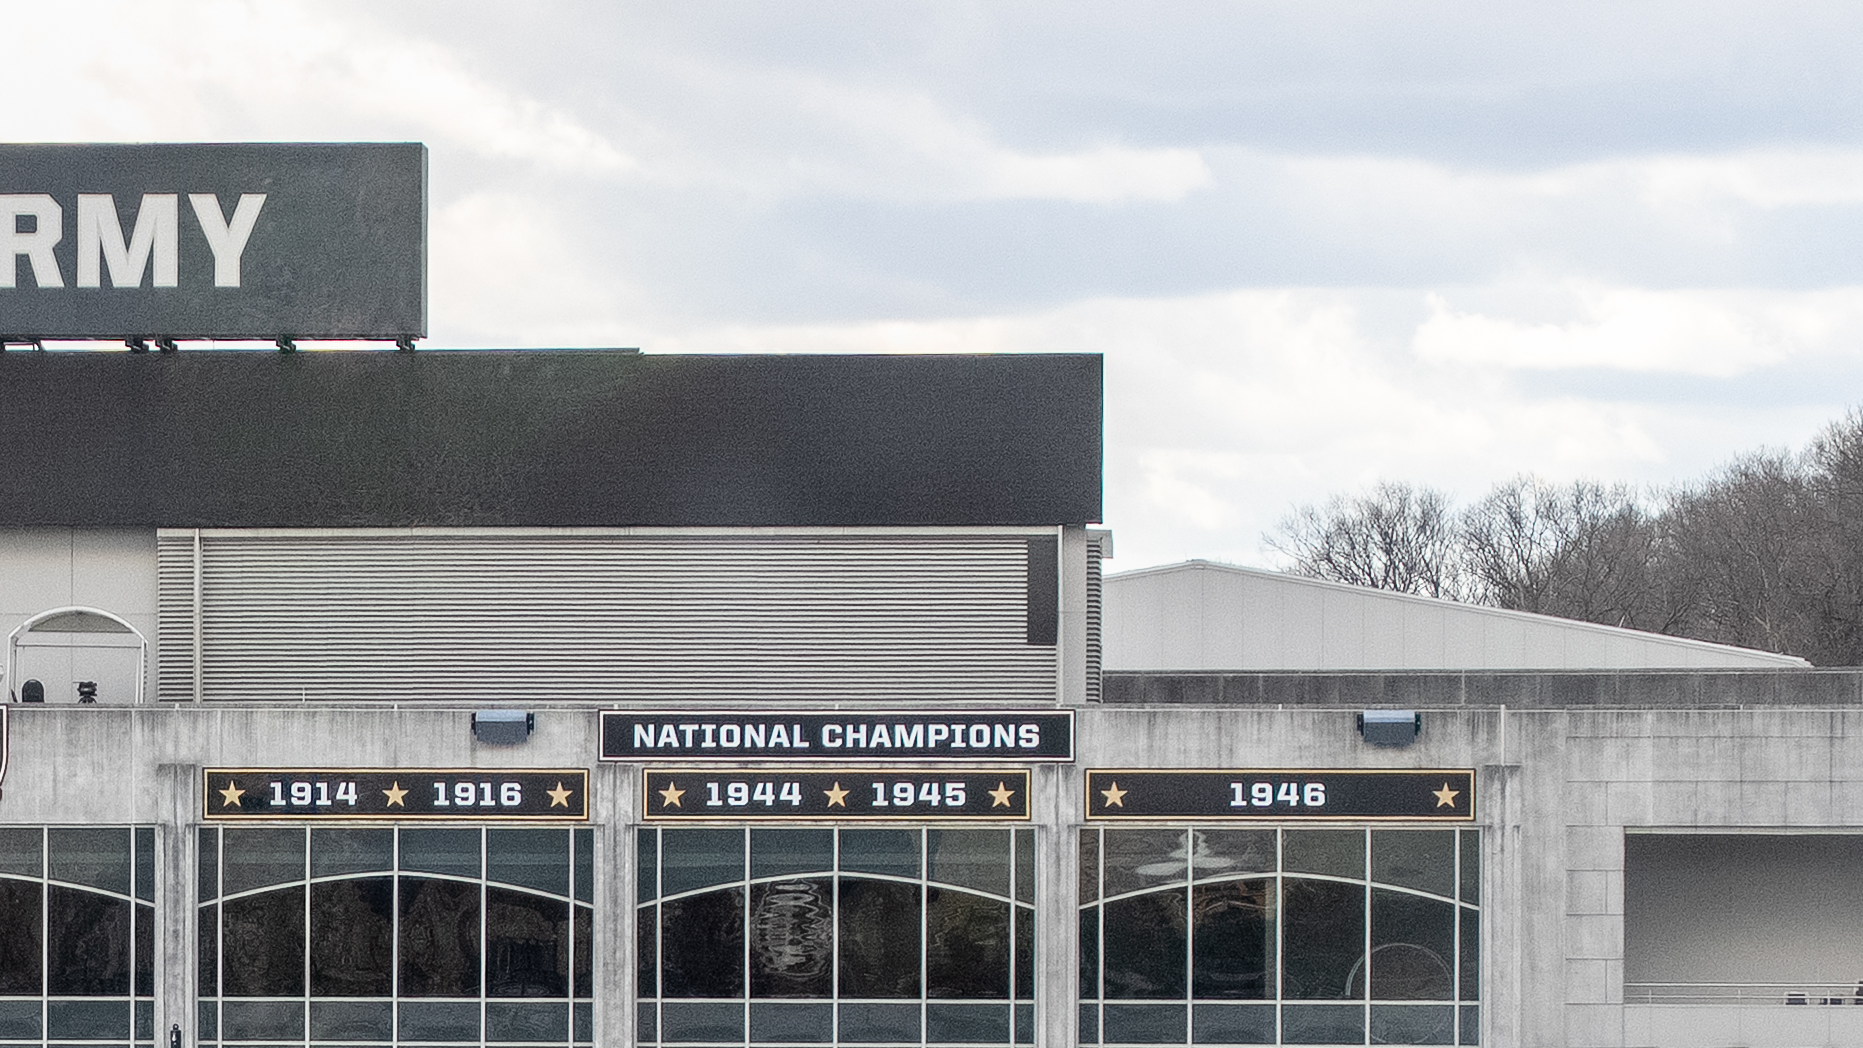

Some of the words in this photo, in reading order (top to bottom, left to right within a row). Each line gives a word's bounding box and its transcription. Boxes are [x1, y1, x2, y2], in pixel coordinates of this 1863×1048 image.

[634, 723, 810, 749] NATIONAL
[822, 723, 1041, 749] CHAMPIONS
[270, 782, 359, 807] 1914
[433, 782, 523, 808] 1916
[706, 783, 803, 807] 1944
[872, 783, 967, 808] 1945
[1230, 783, 1327, 808] 1946
